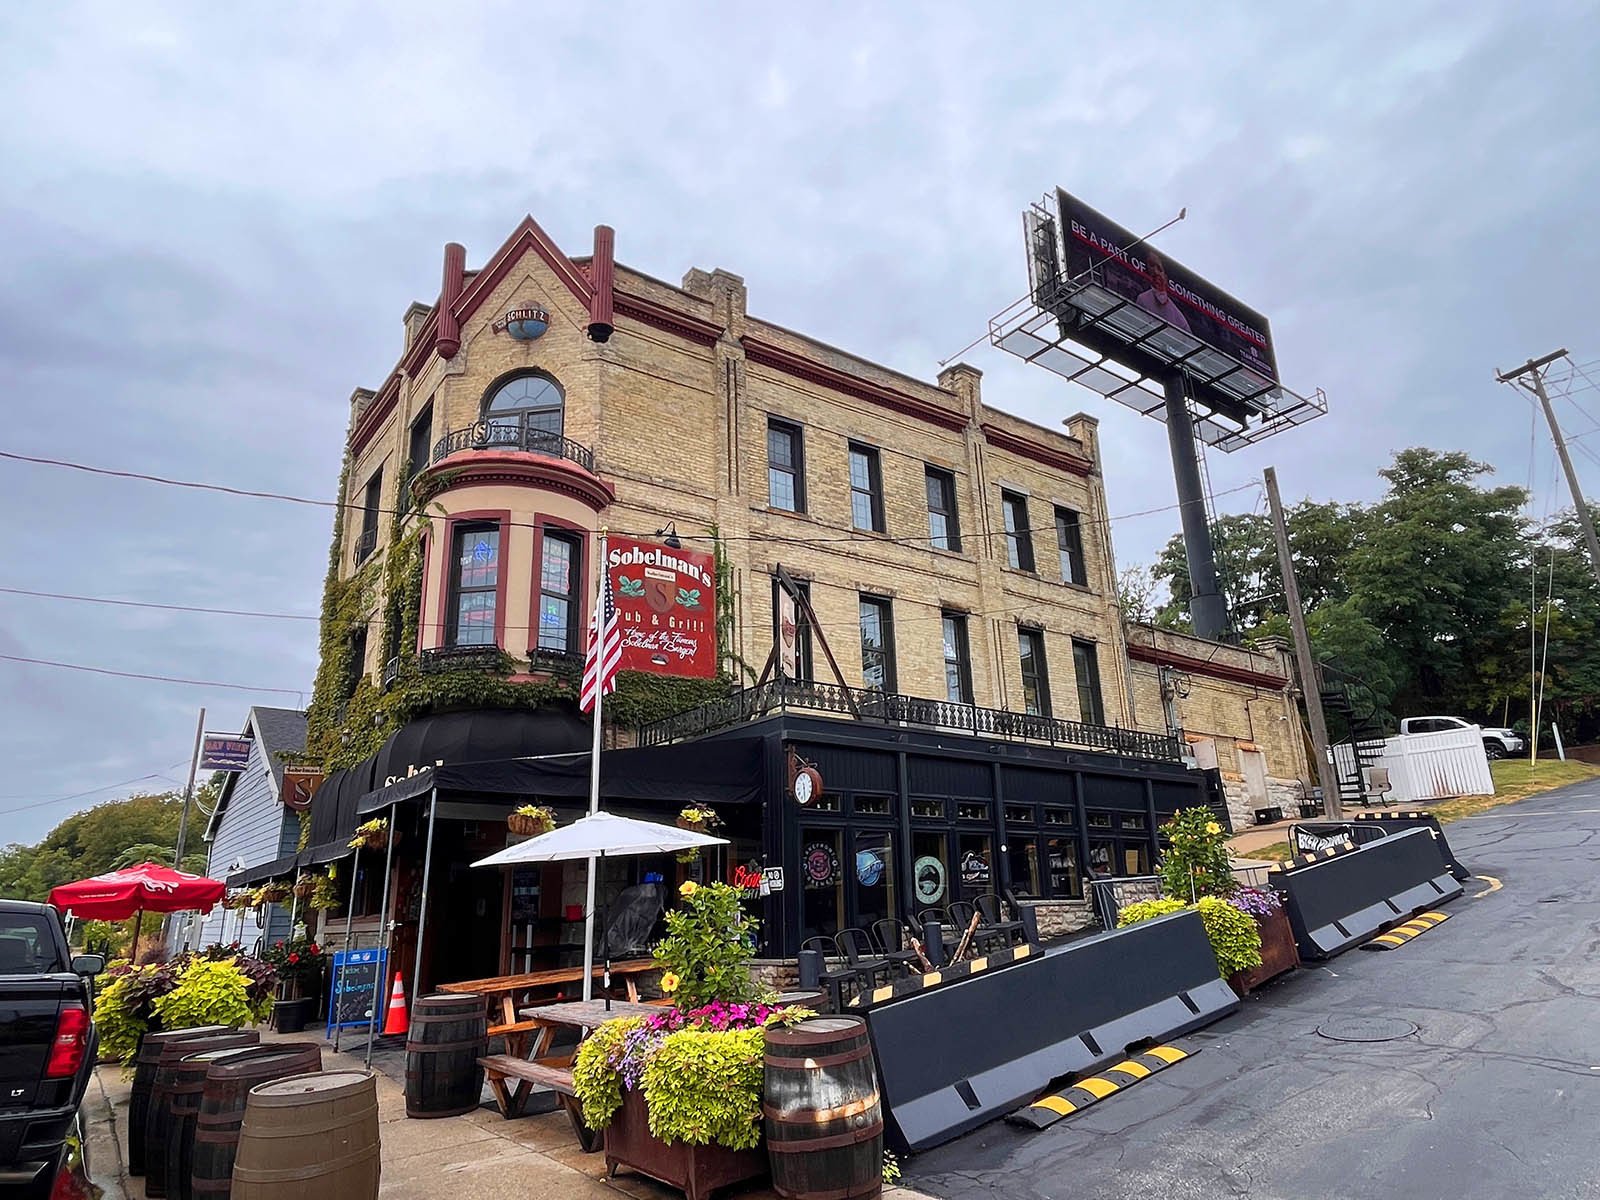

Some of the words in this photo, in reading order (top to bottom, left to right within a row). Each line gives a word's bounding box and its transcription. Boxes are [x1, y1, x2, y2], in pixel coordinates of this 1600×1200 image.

[1071, 220, 1087, 239] BE
[1090, 232, 1099, 246] A
[1100, 238, 1129, 263] PART
[1131, 257, 1147, 273] OF
[507, 310, 545, 322] SCHLITZ
[1168, 279, 1226, 321] SOMETHING
[1227, 315, 1266, 344] GREATER
[609, 547, 711, 588] Sobelman's
[651, 614, 659, 626] &
[669, 616, 703, 633] Grill
[11, 1089, 25, 1097] LT
